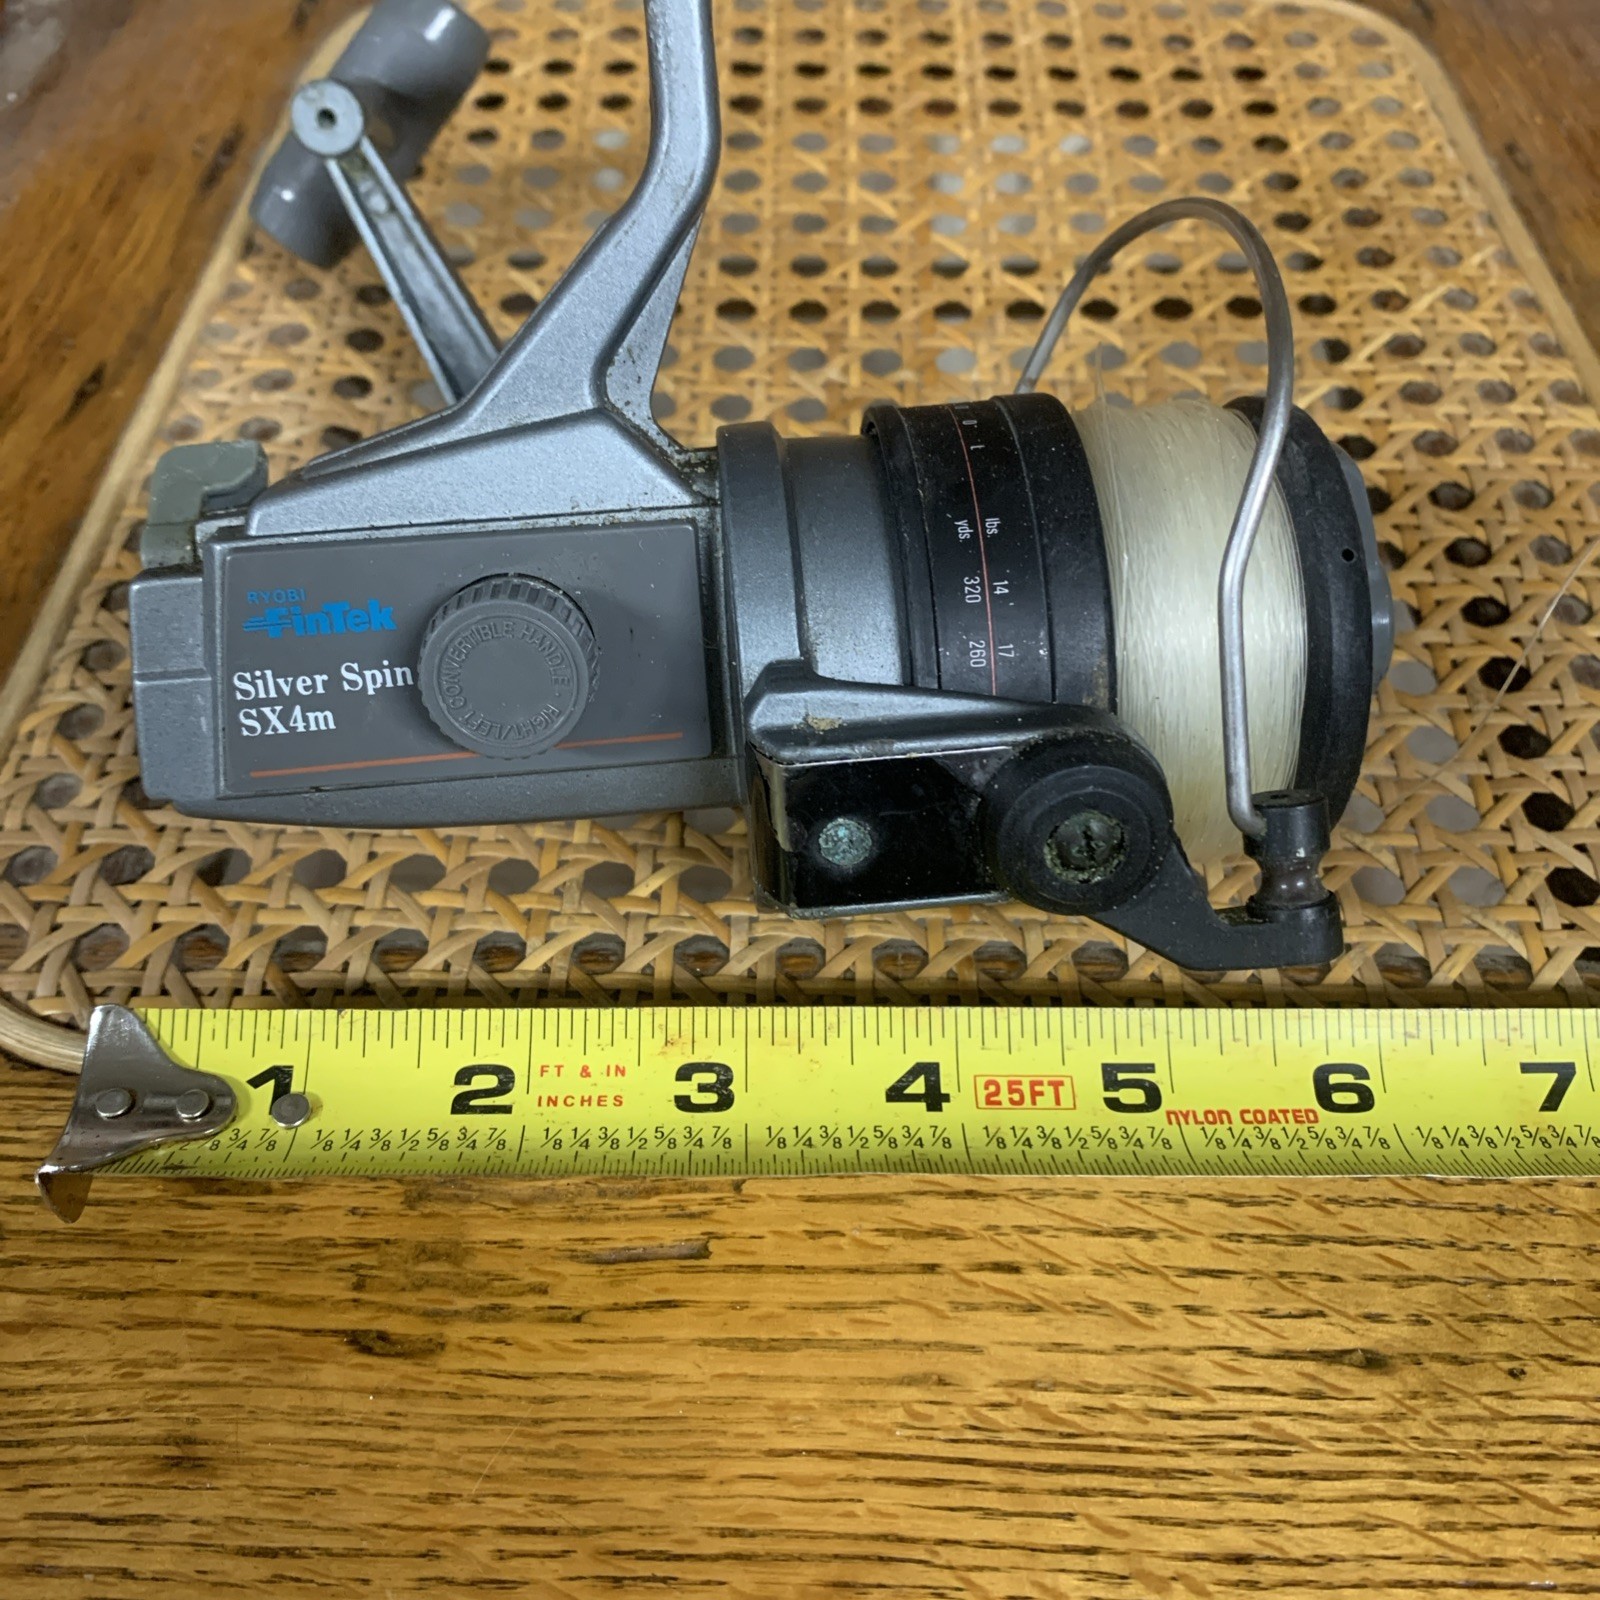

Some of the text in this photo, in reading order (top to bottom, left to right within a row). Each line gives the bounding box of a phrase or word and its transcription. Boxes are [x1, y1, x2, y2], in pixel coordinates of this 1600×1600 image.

[247, 586, 306, 604] RYOBI
[954, 519, 987, 668] yds. 320 260
[985, 517, 1015, 658] lbs. 14 17
[242, 597, 397, 638] FinTek
[233, 659, 414, 700] Silver Spin
[440, 621, 515, 710] CONVERTIBLE
[519, 623, 571, 688] HANDLE
[238, 704, 336, 736] SX4m
[246, 1061, 1577, 1115] 1 2 3 4 5 6 7
[540, 1064, 627, 1078] FT & IN
[537, 1094, 625, 1108] INCHES
[983, 1079, 1064, 1106] 25FT
[1239, 1108, 1320, 1125] COATED
